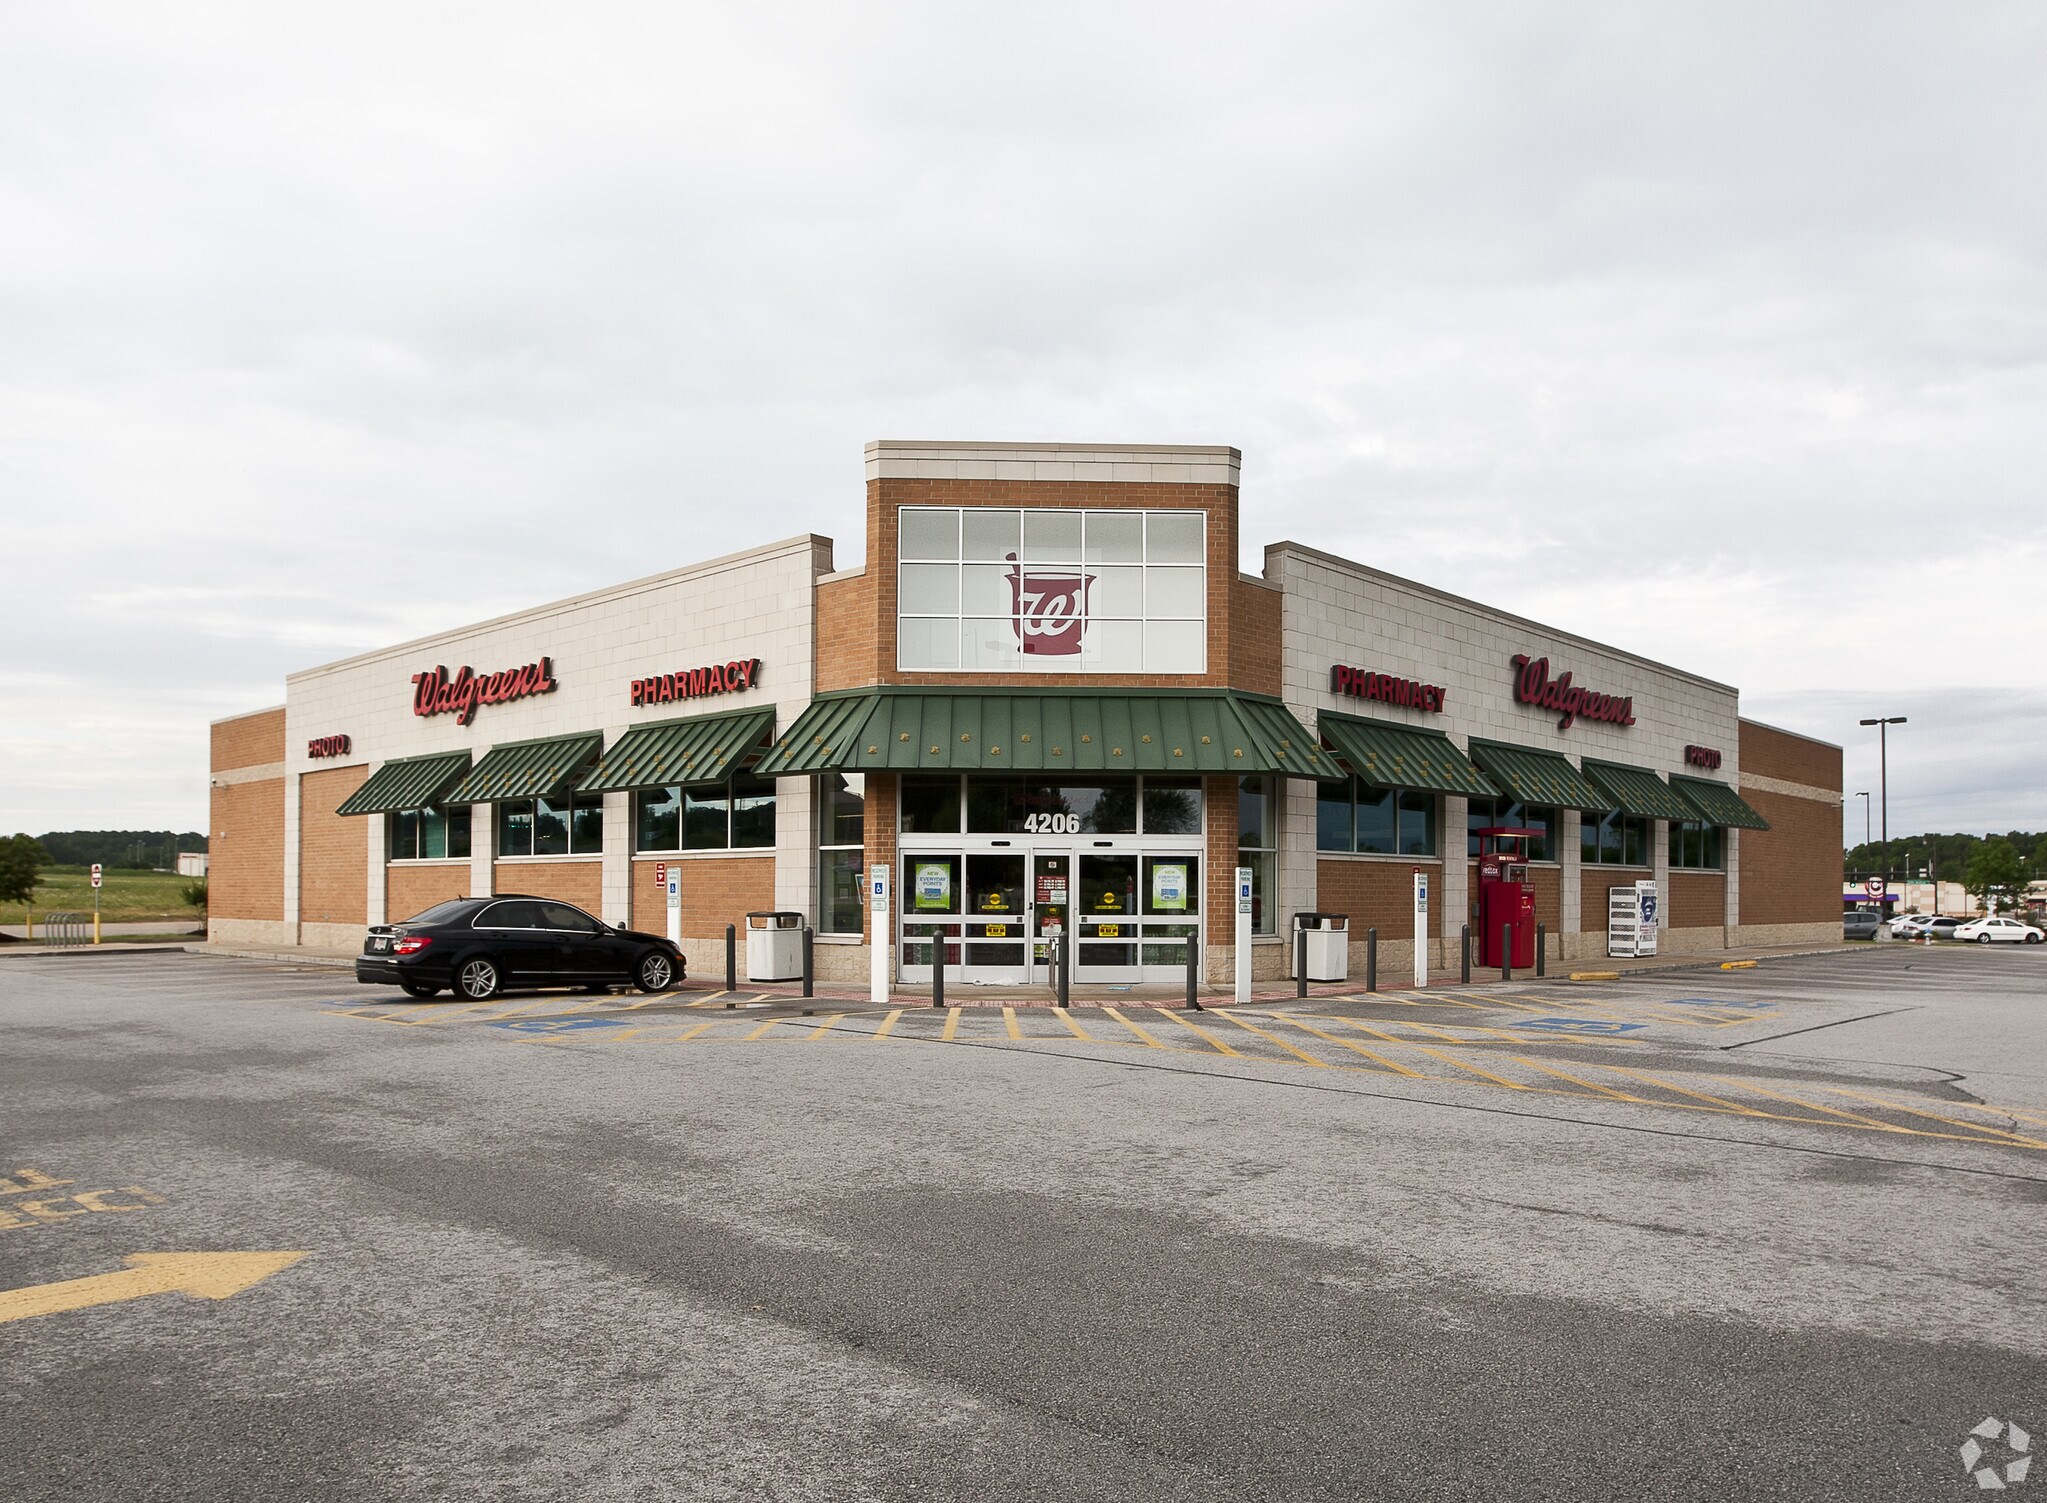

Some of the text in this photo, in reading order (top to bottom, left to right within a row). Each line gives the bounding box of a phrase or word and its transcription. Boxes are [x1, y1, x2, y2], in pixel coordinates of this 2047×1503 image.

[411, 656, 557, 727] Walgreens
[631, 658, 762, 707] PHARMACY
[1331, 664, 1447, 713] PHARMACY
[1511, 653, 1637, 730] Walgreens
[307, 734, 351, 758] PHOTO
[1685, 744, 1722, 769] PHOTO
[1023, 813, 1080, 834] 4206
